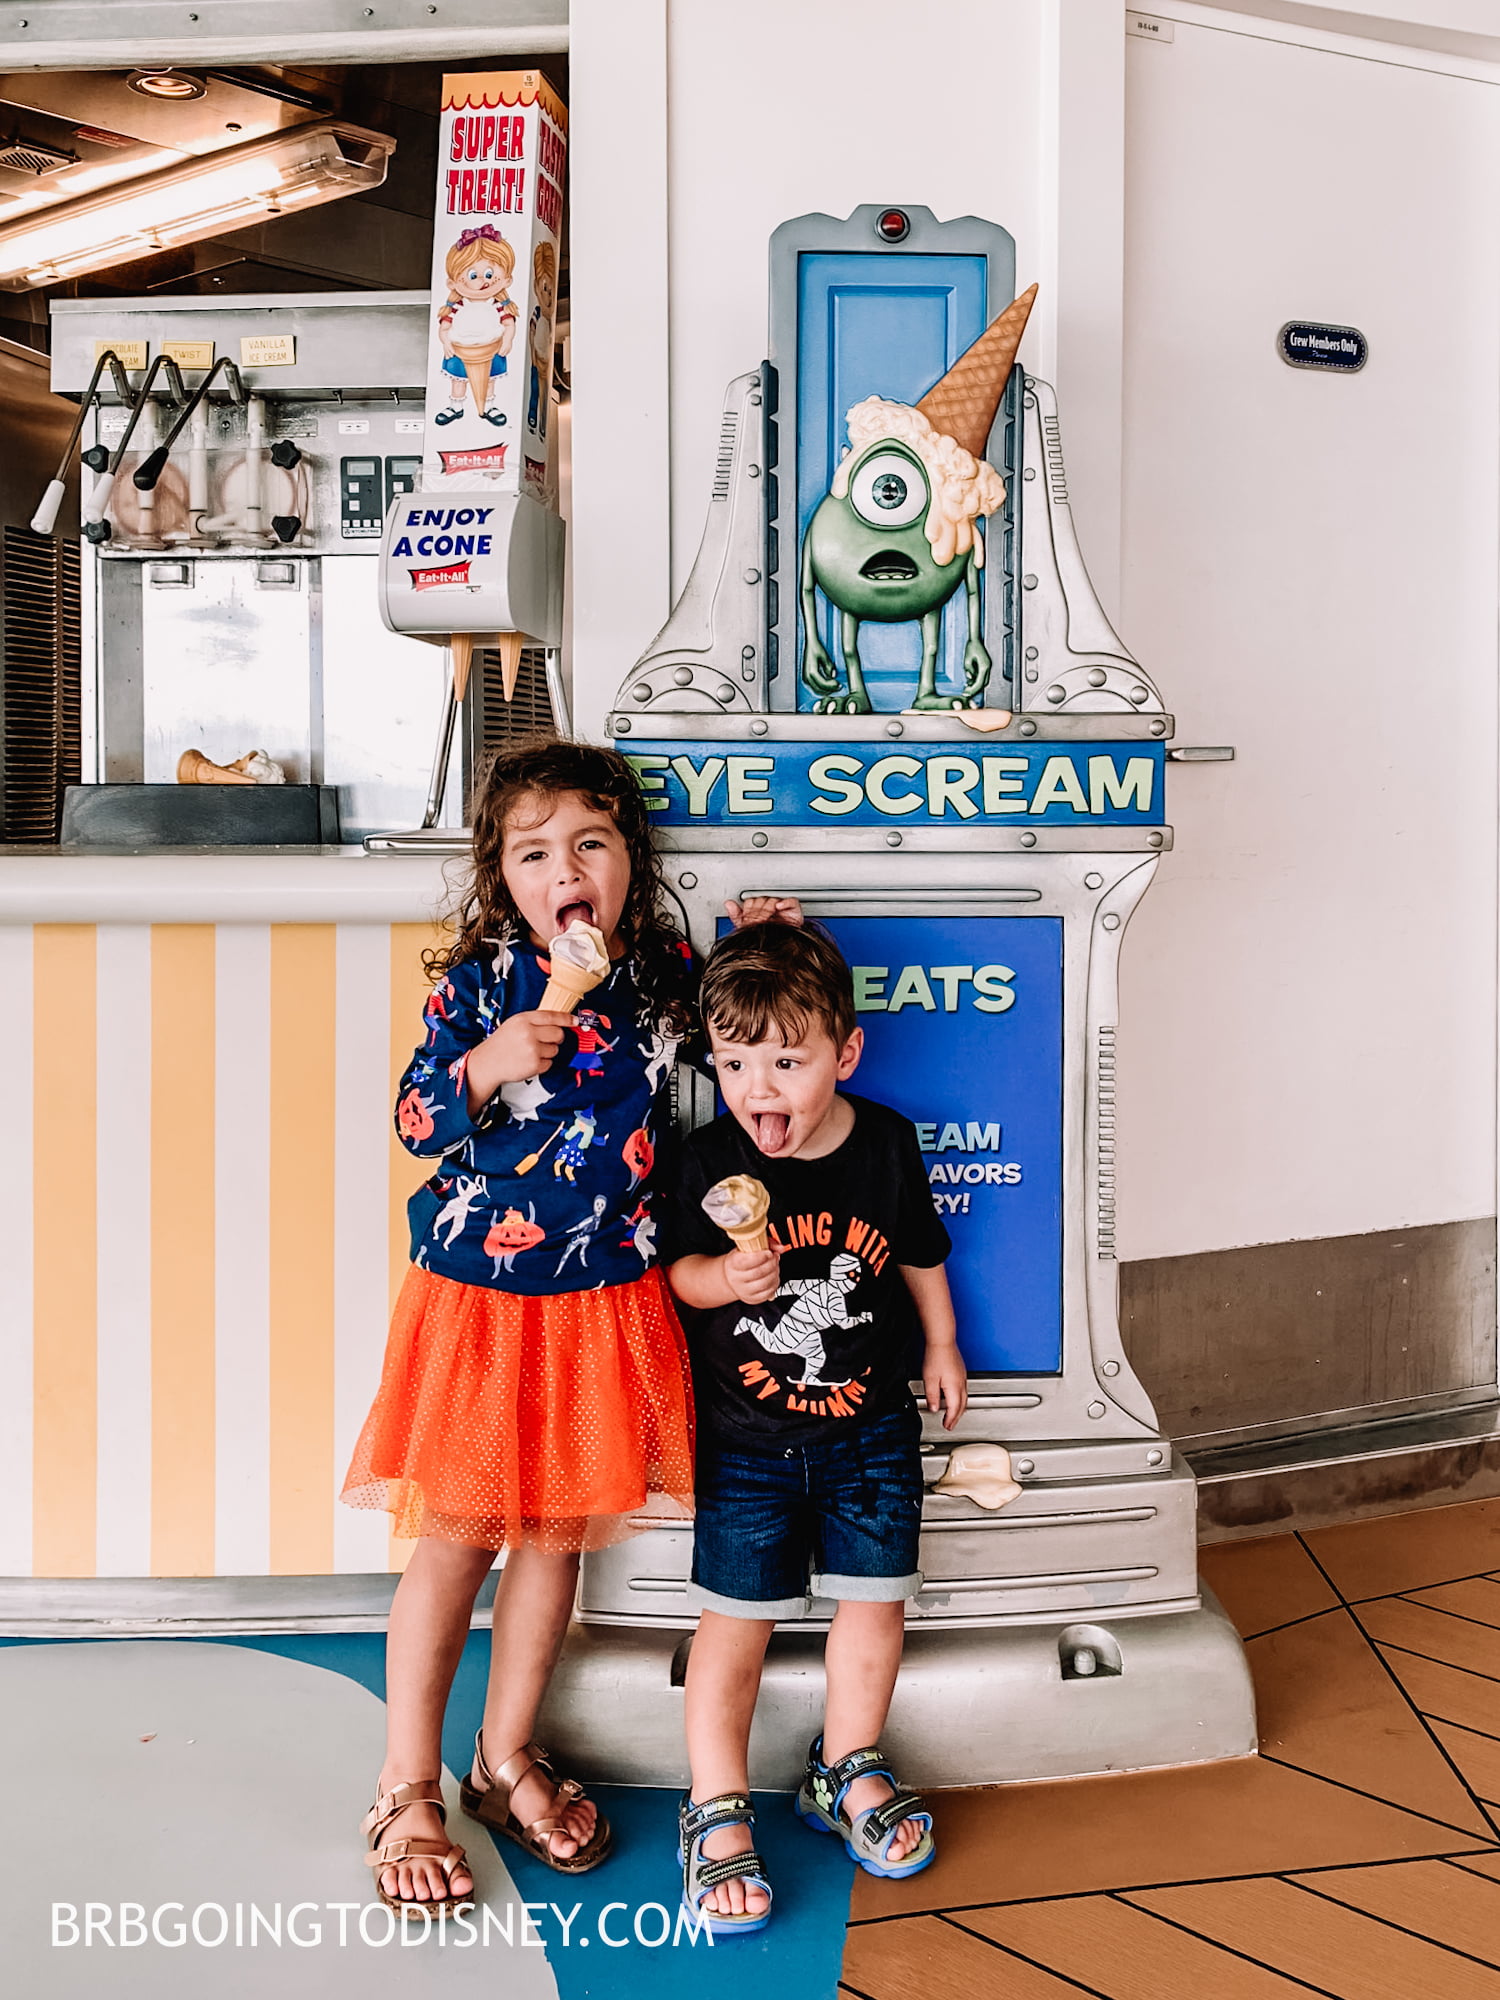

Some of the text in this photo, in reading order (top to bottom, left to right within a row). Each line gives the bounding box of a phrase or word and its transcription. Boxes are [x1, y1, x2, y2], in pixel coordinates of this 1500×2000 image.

[450, 115, 525, 163] SUPER
[446, 167, 526, 215] TREAT!
[173, 350, 201, 359] TWIST
[248, 339, 286, 349] VANILLA
[249, 352, 287, 363] ICE CREAM
[1290, 332, 1308, 347] Crew
[1308, 334, 1340, 351] Members
[1341, 338, 1358, 356] Only
[406, 507, 495, 531] ENJOY
[392, 535, 493, 557] A CONE
[623, 753, 1155, 819] EYE SCREAM
[852, 965, 1016, 1014] EATS
[915, 1121, 1001, 1152] EAM
[928, 1163, 1022, 1185] AVORS
[768, 1211, 833, 1250] LING
[738, 1360, 781, 1401] MY
